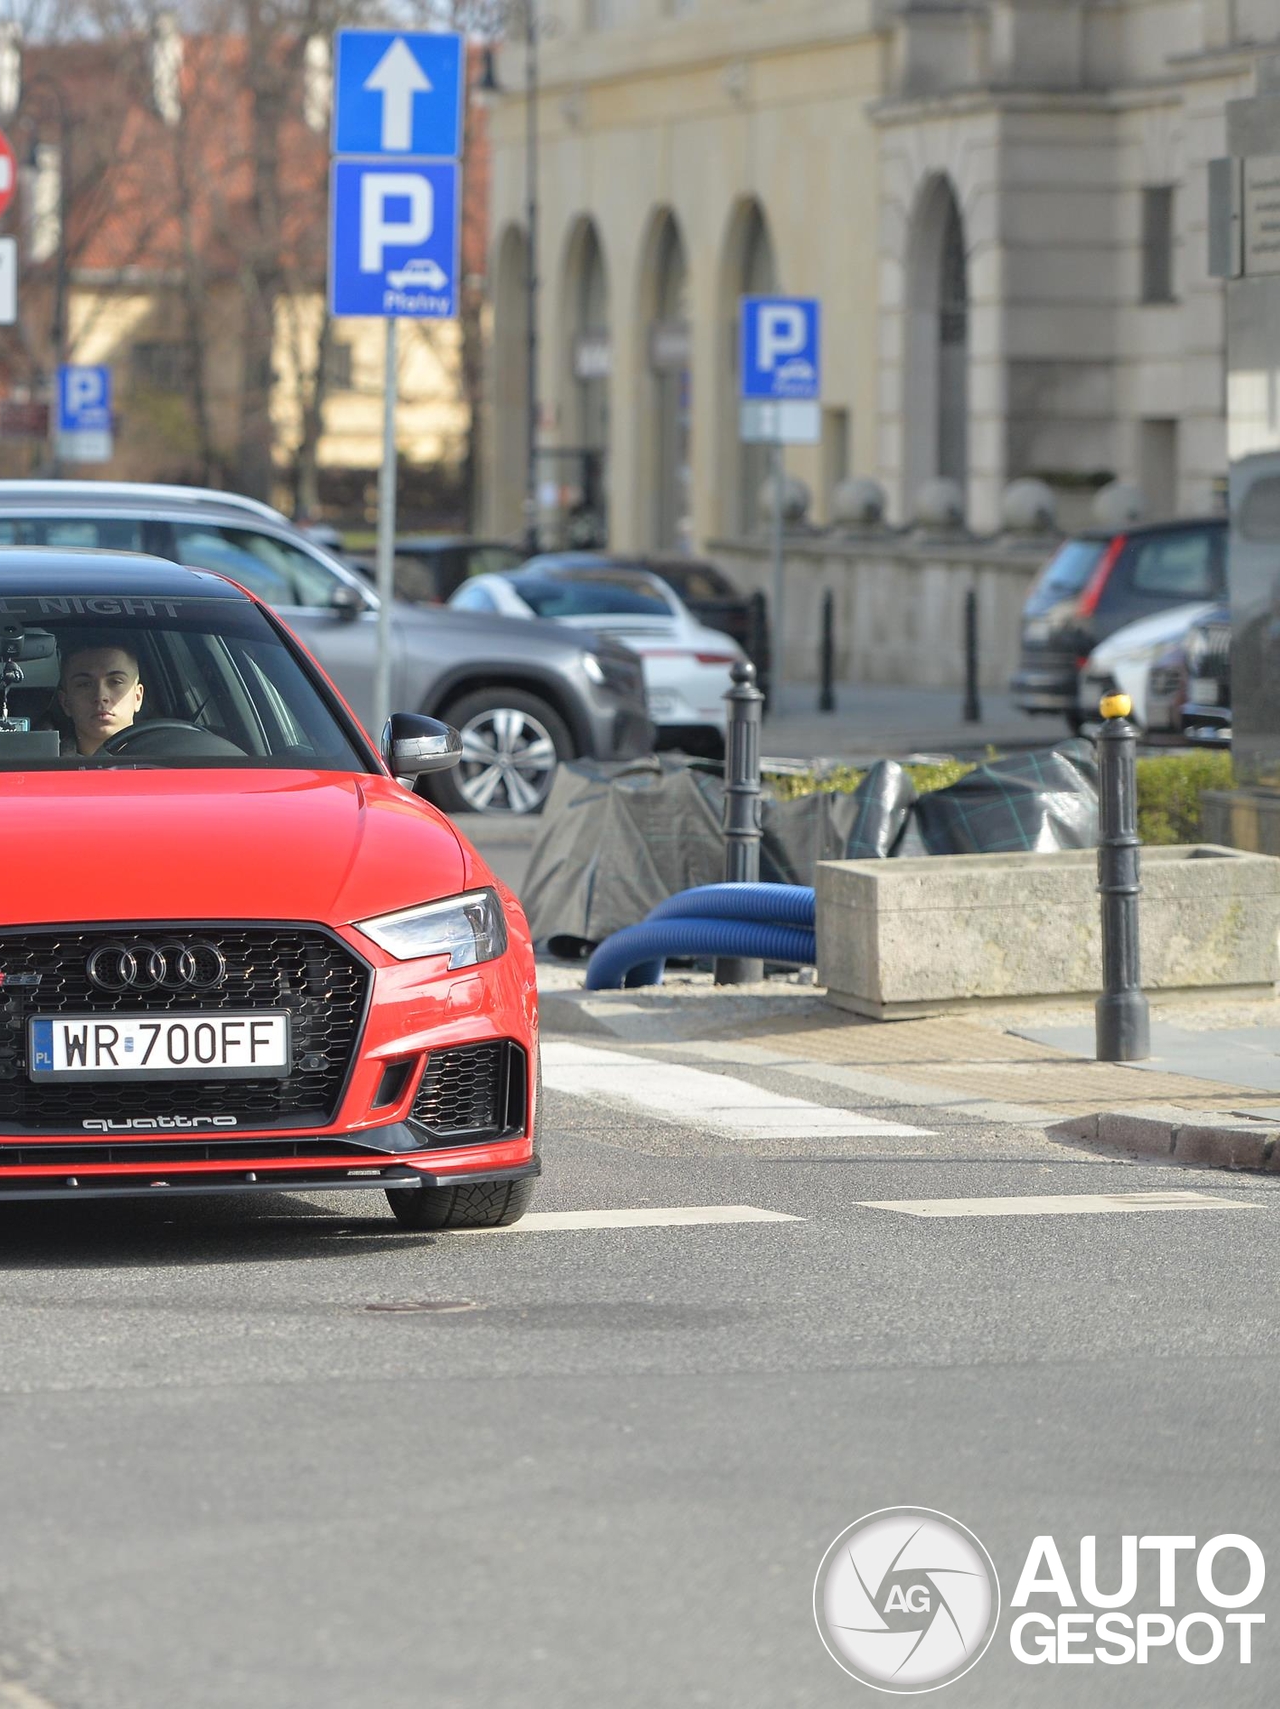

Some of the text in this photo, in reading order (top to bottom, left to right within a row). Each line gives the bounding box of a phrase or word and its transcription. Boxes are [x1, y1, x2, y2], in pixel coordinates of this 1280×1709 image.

[361, 173, 433, 273] P
[758, 306, 806, 371] P
[67, 368, 100, 412] P
[38, 598, 182, 618] NIGHT
[35, 1052, 52, 1064] PL
[63, 1021, 274, 1067] WR 700FF
[82, 1114, 238, 1132] quattro
